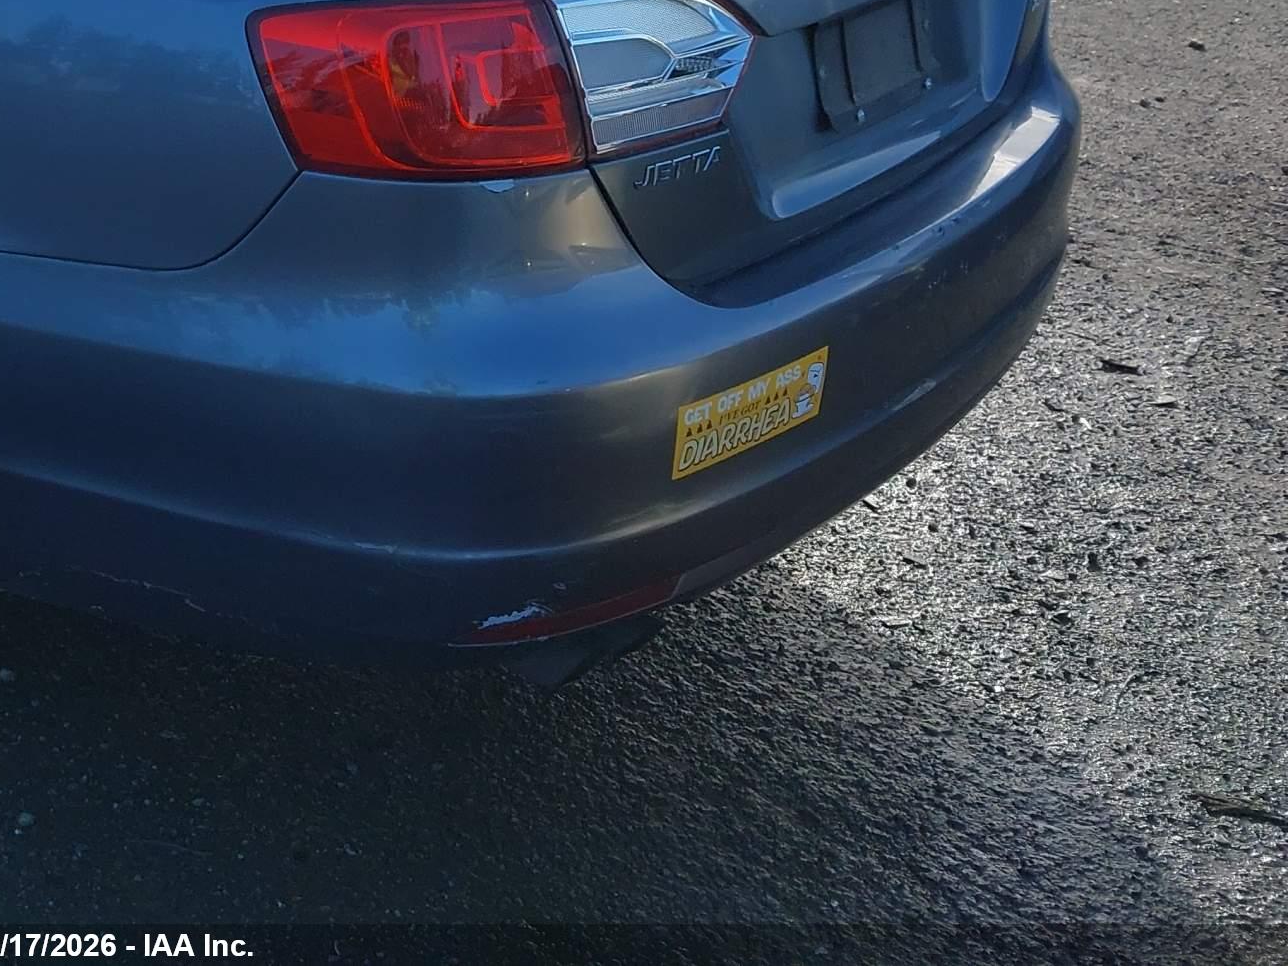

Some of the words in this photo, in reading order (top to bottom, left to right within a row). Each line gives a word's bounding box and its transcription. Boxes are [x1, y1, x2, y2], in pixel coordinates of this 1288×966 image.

[632, 146, 720, 188] JETTA
[684, 402, 712, 426] GET
[717, 390, 744, 413] OFF
[748, 378, 771, 402] MY
[740, 400, 761, 416] GOT
[678, 397, 792, 472] DIARRHEA
